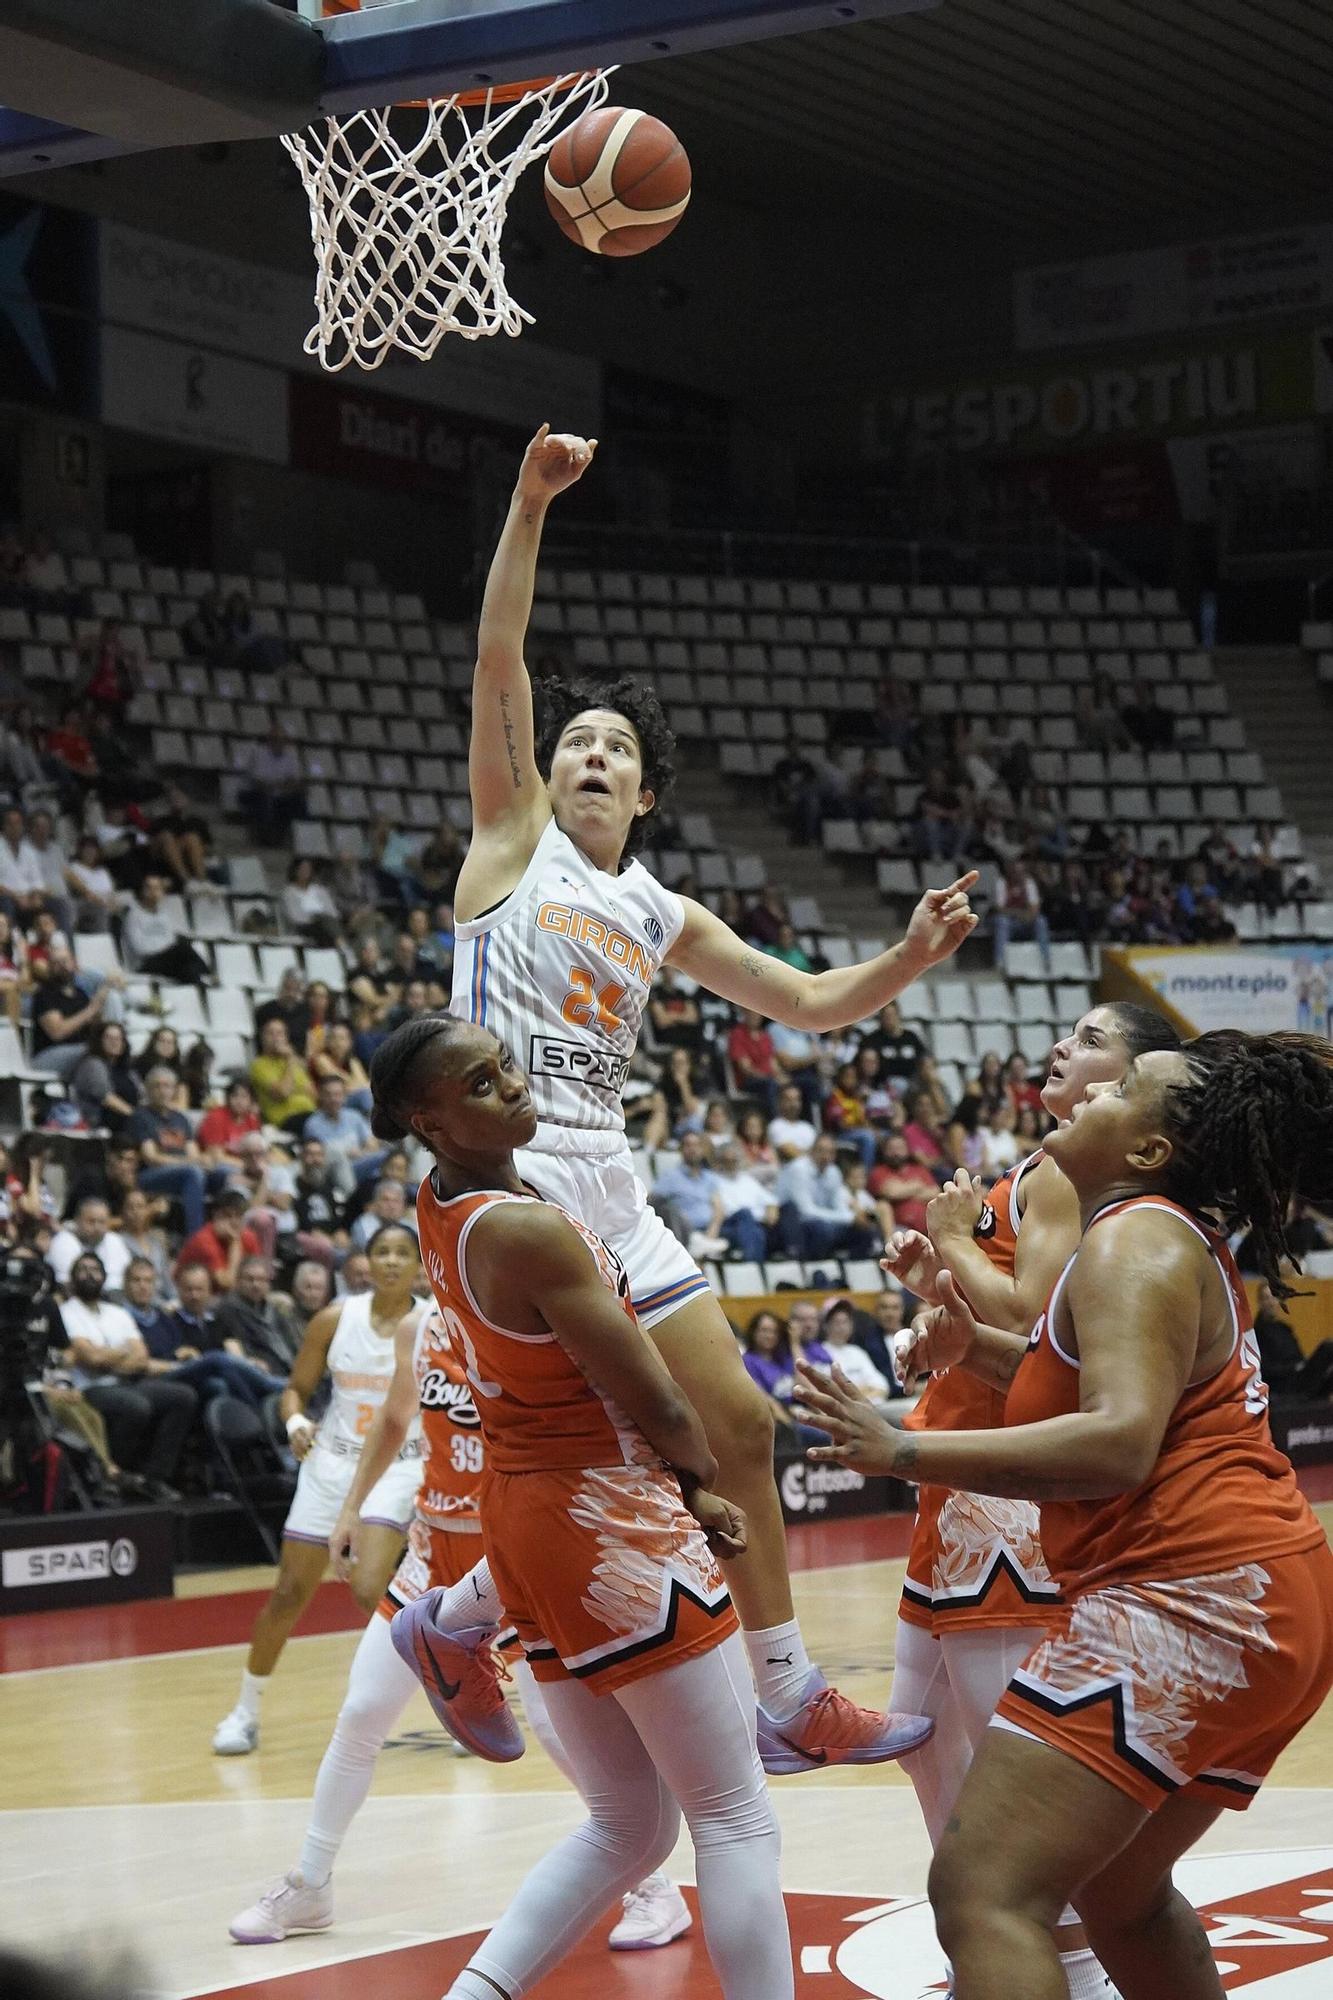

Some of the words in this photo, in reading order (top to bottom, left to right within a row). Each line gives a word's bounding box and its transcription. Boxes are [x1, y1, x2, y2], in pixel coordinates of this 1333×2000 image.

[535, 900, 654, 989] GIRON
[1171, 968, 1288, 998] montepio
[450, 1434, 484, 1473] 39
[28, 1548, 105, 1577] SPAR
